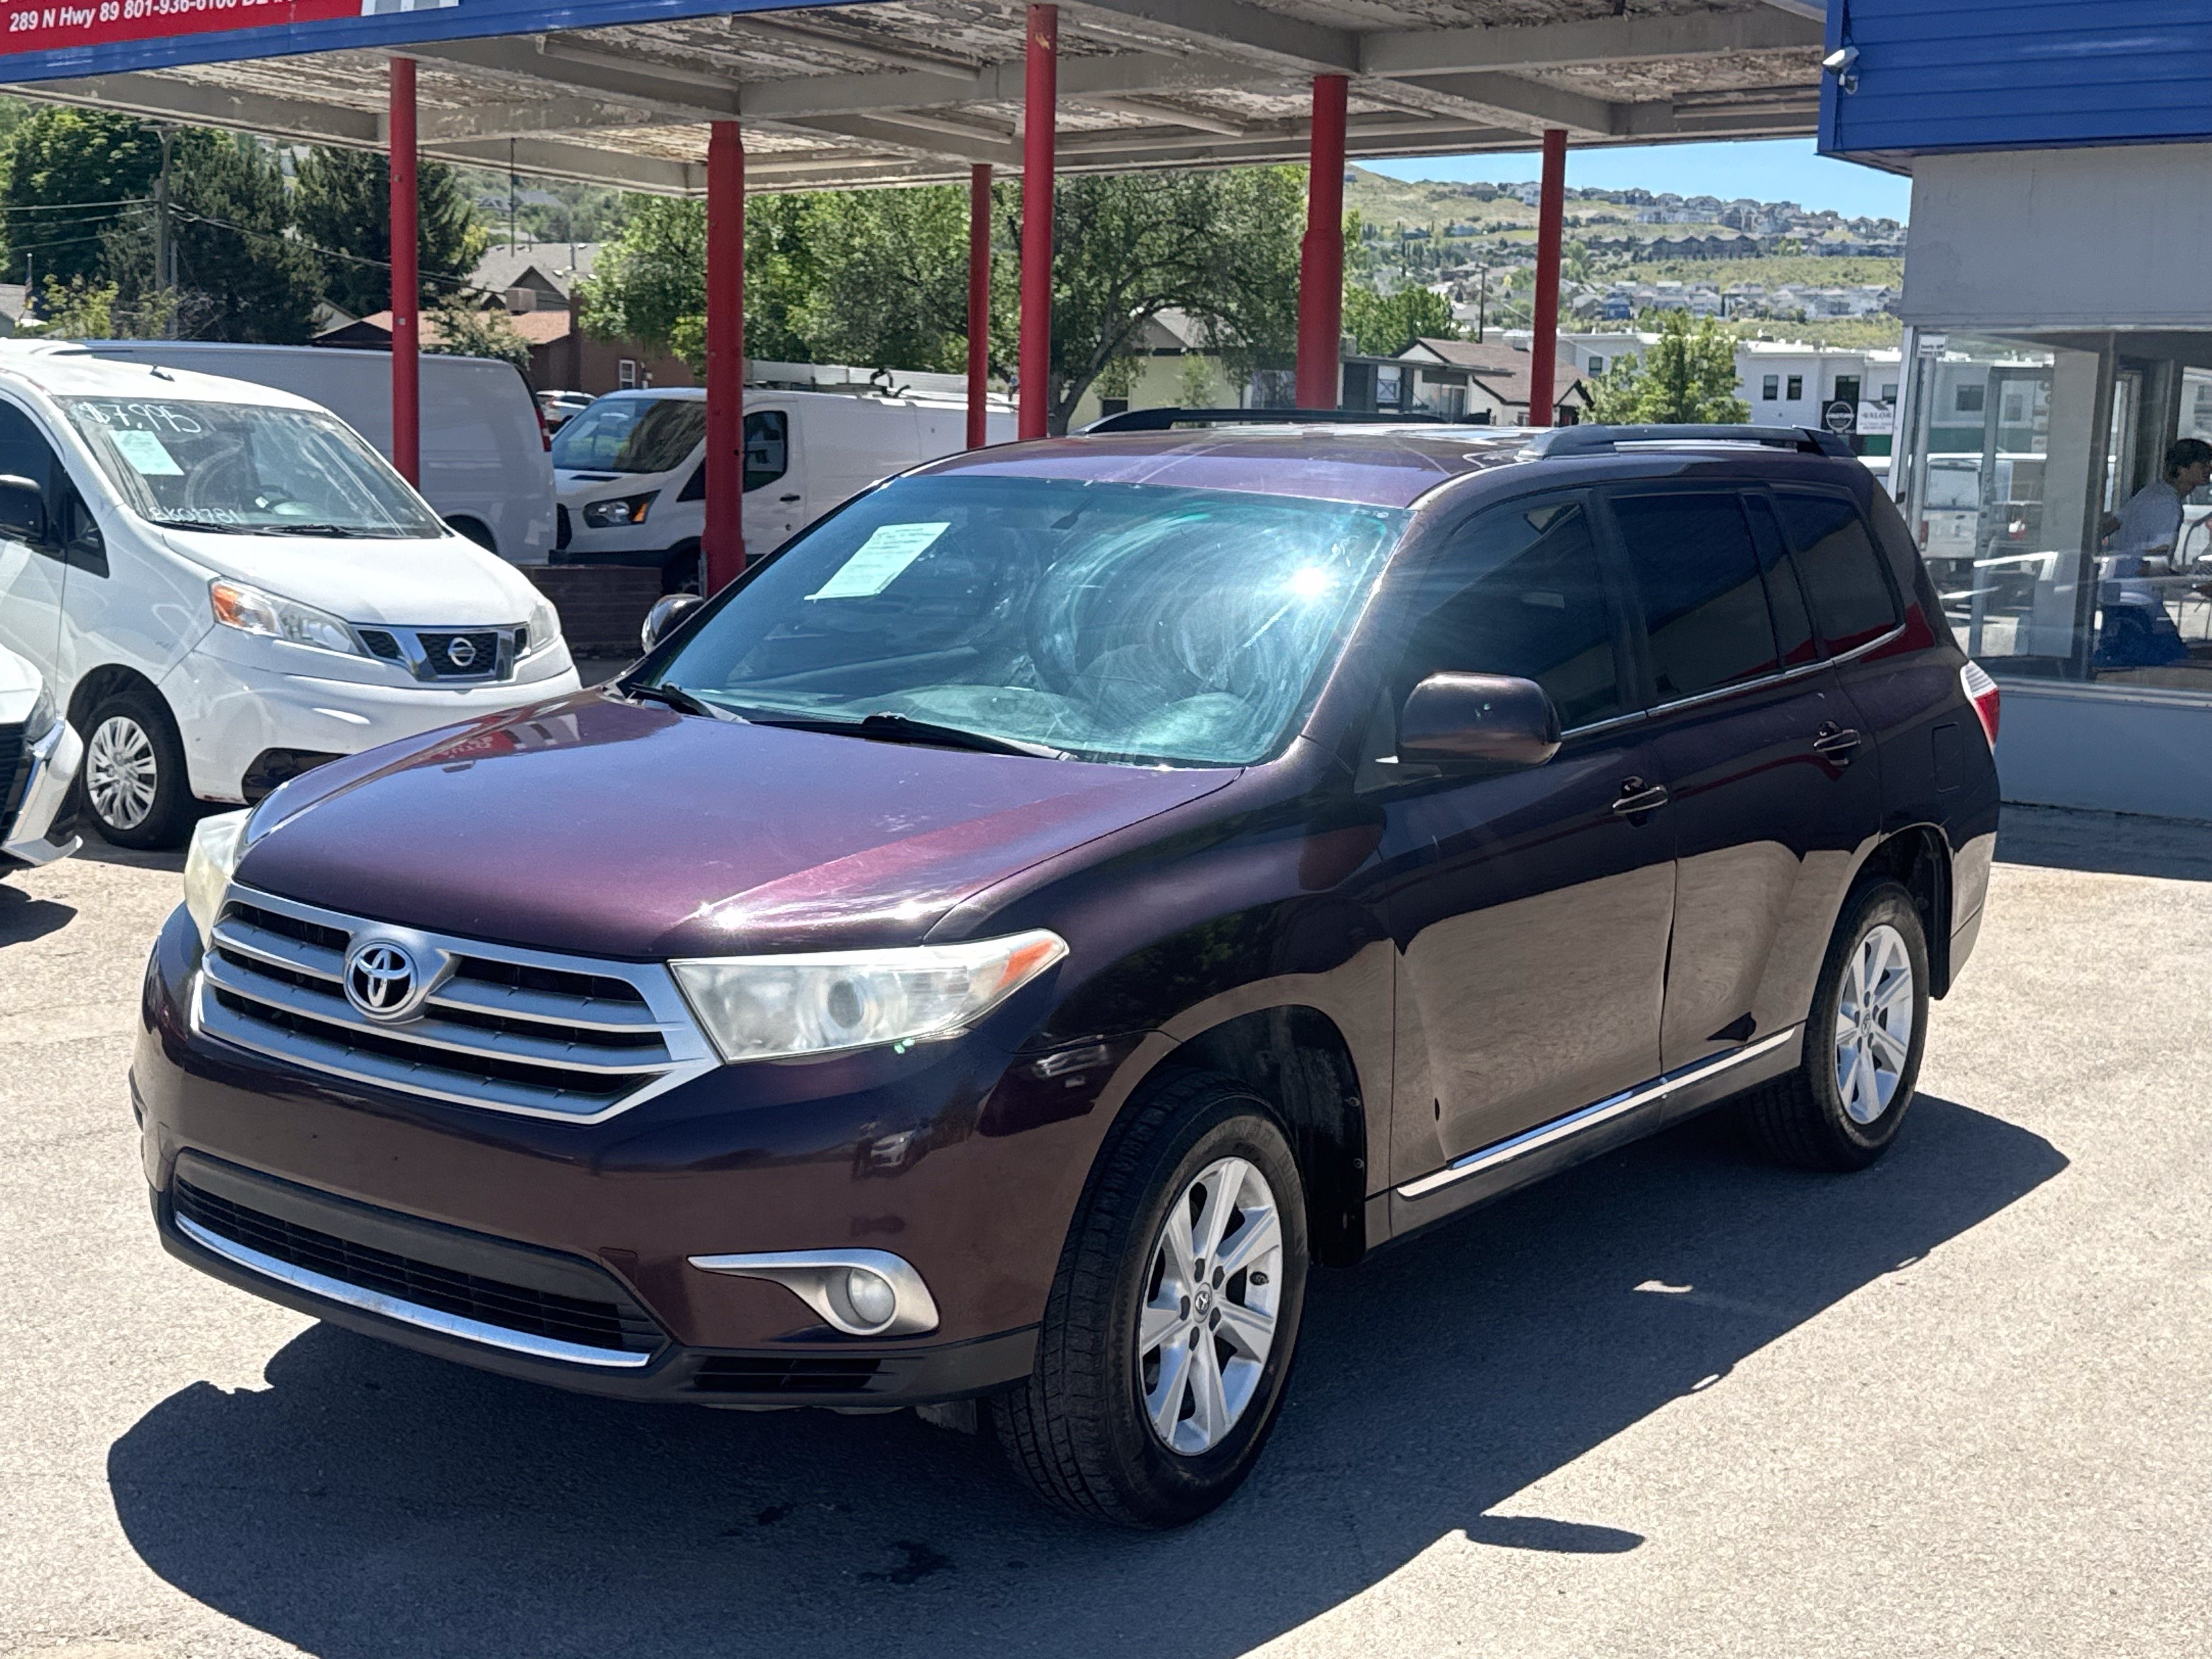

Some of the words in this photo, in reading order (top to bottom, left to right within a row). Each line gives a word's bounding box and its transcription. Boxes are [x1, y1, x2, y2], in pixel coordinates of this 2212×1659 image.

[9, 11, 38, 32] 289
[42, 8, 56, 28] N
[59, 6, 96, 28] Hwy
[99, 1, 120, 21] 89
